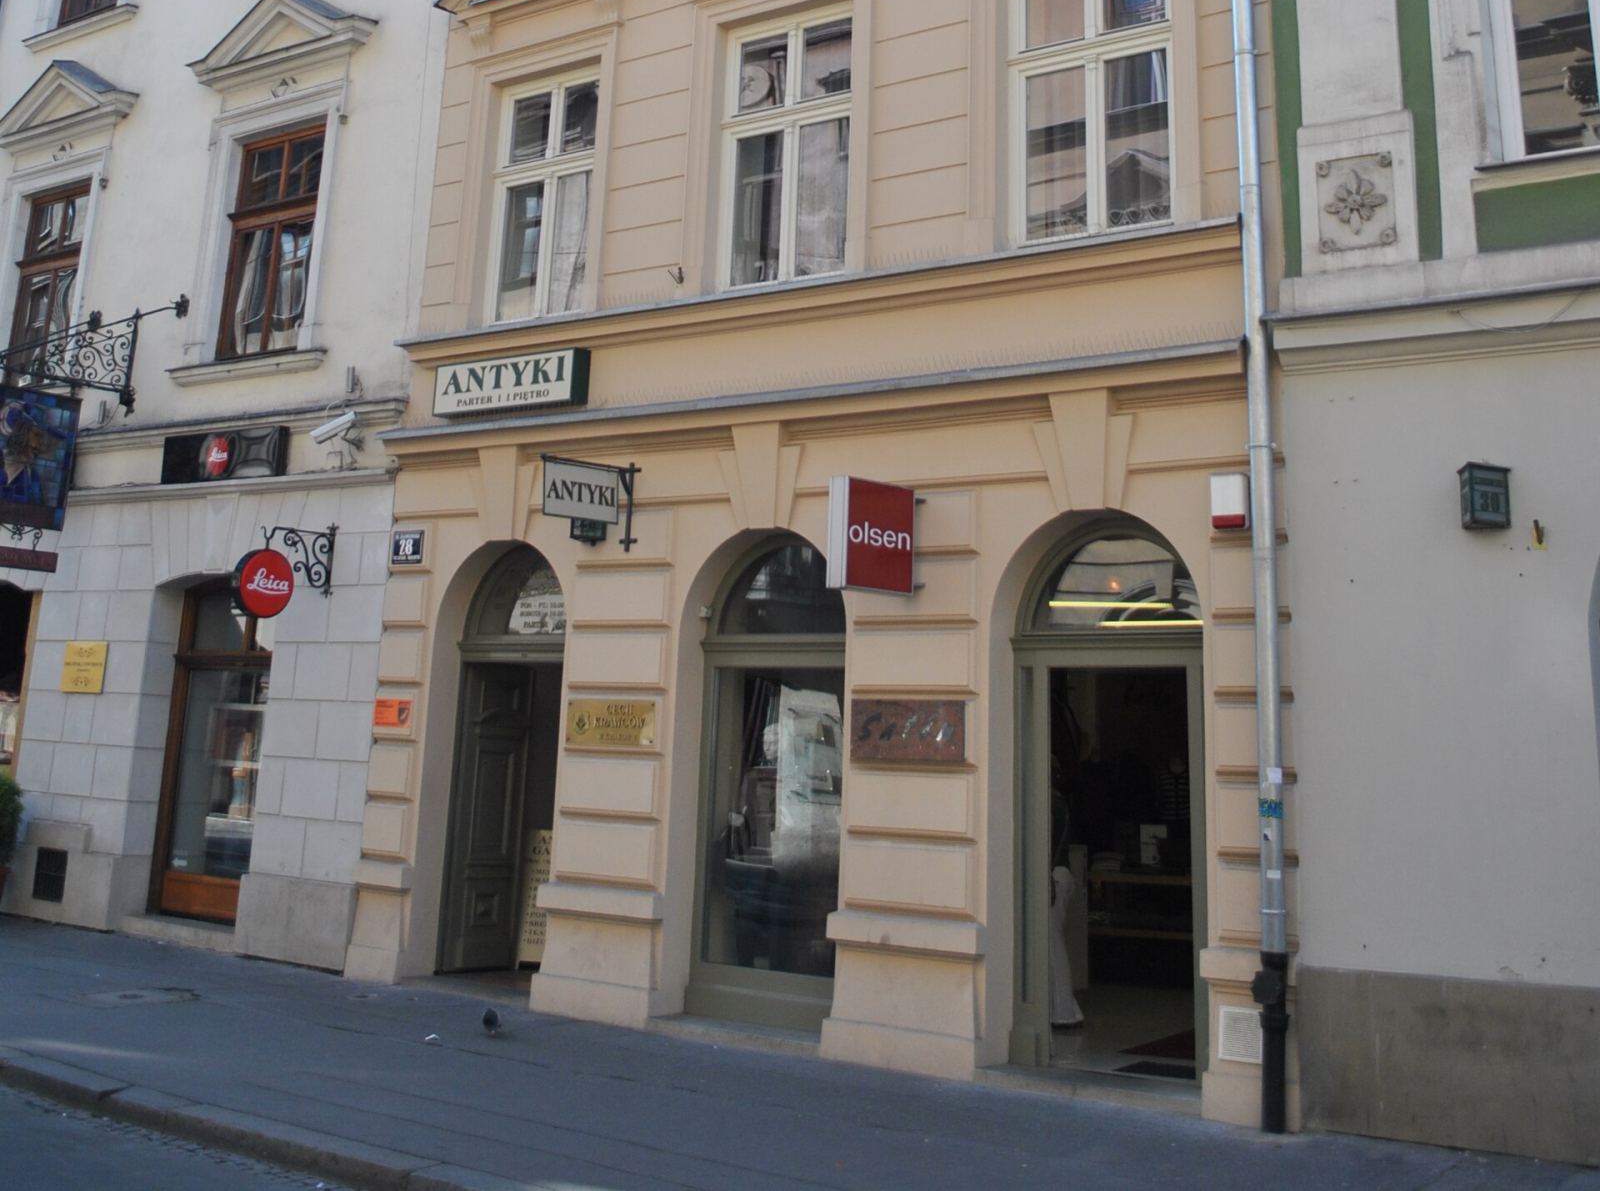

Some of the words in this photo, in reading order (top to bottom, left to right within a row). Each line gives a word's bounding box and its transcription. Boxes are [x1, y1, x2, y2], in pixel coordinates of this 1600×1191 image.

[442, 355, 566, 396] ANTYKI
[456, 395, 493, 408] PARTER
[513, 388, 550, 402] PIĘTRO
[208, 447, 228, 462] Leica
[546, 478, 616, 508] ANTYKI
[399, 538, 413, 555] 28
[849, 521, 911, 551] olsen
[246, 567, 289, 595] Leica
